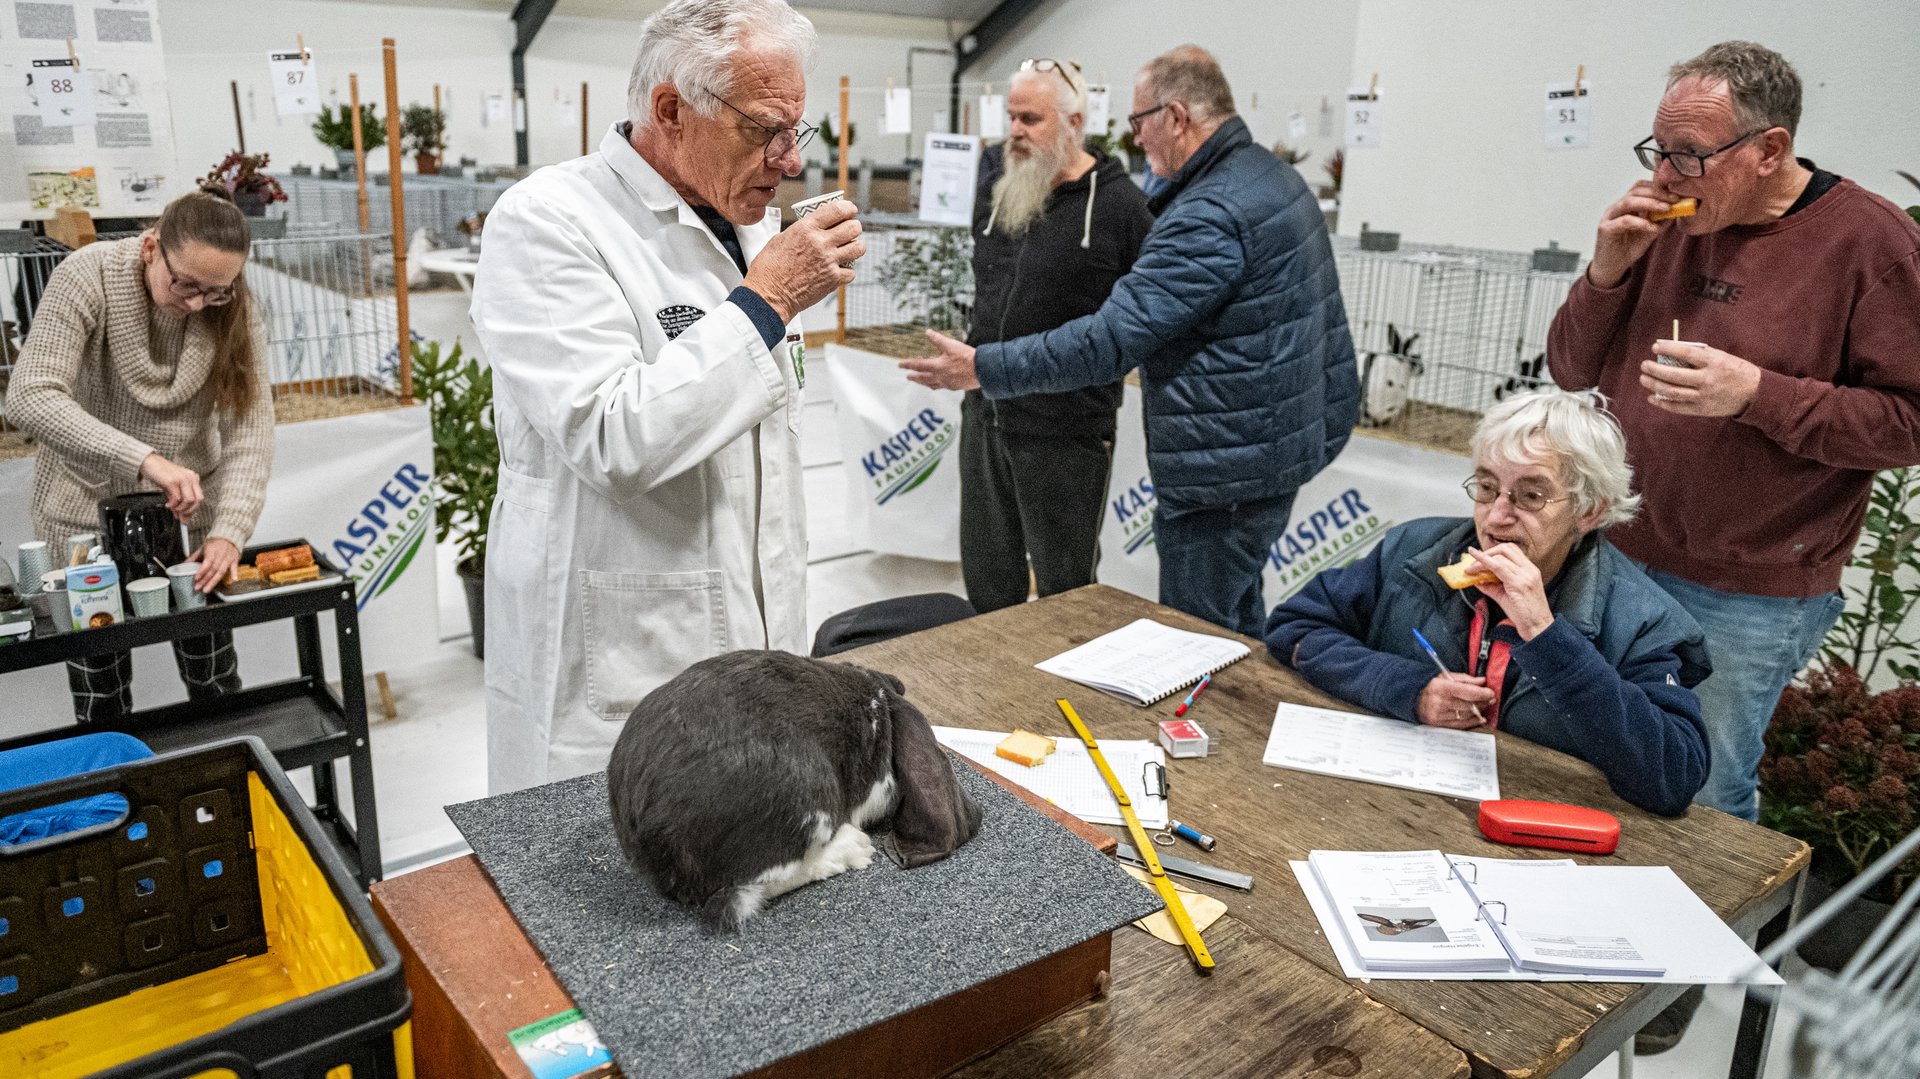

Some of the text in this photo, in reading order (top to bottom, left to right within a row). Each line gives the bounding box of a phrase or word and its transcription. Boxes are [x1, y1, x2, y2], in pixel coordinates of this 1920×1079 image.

[51, 79, 73, 93] 88
[287, 71, 304, 85] 87
[1354, 110, 1370, 124] 52
[1559, 109, 1576, 123] 51
[862, 407, 944, 477] KASPER
[332, 462, 430, 567] ASPER
[1113, 476, 1154, 523] KAS
[350, 482, 434, 581] AUNAFOO
[1269, 488, 1371, 571] KASPER
